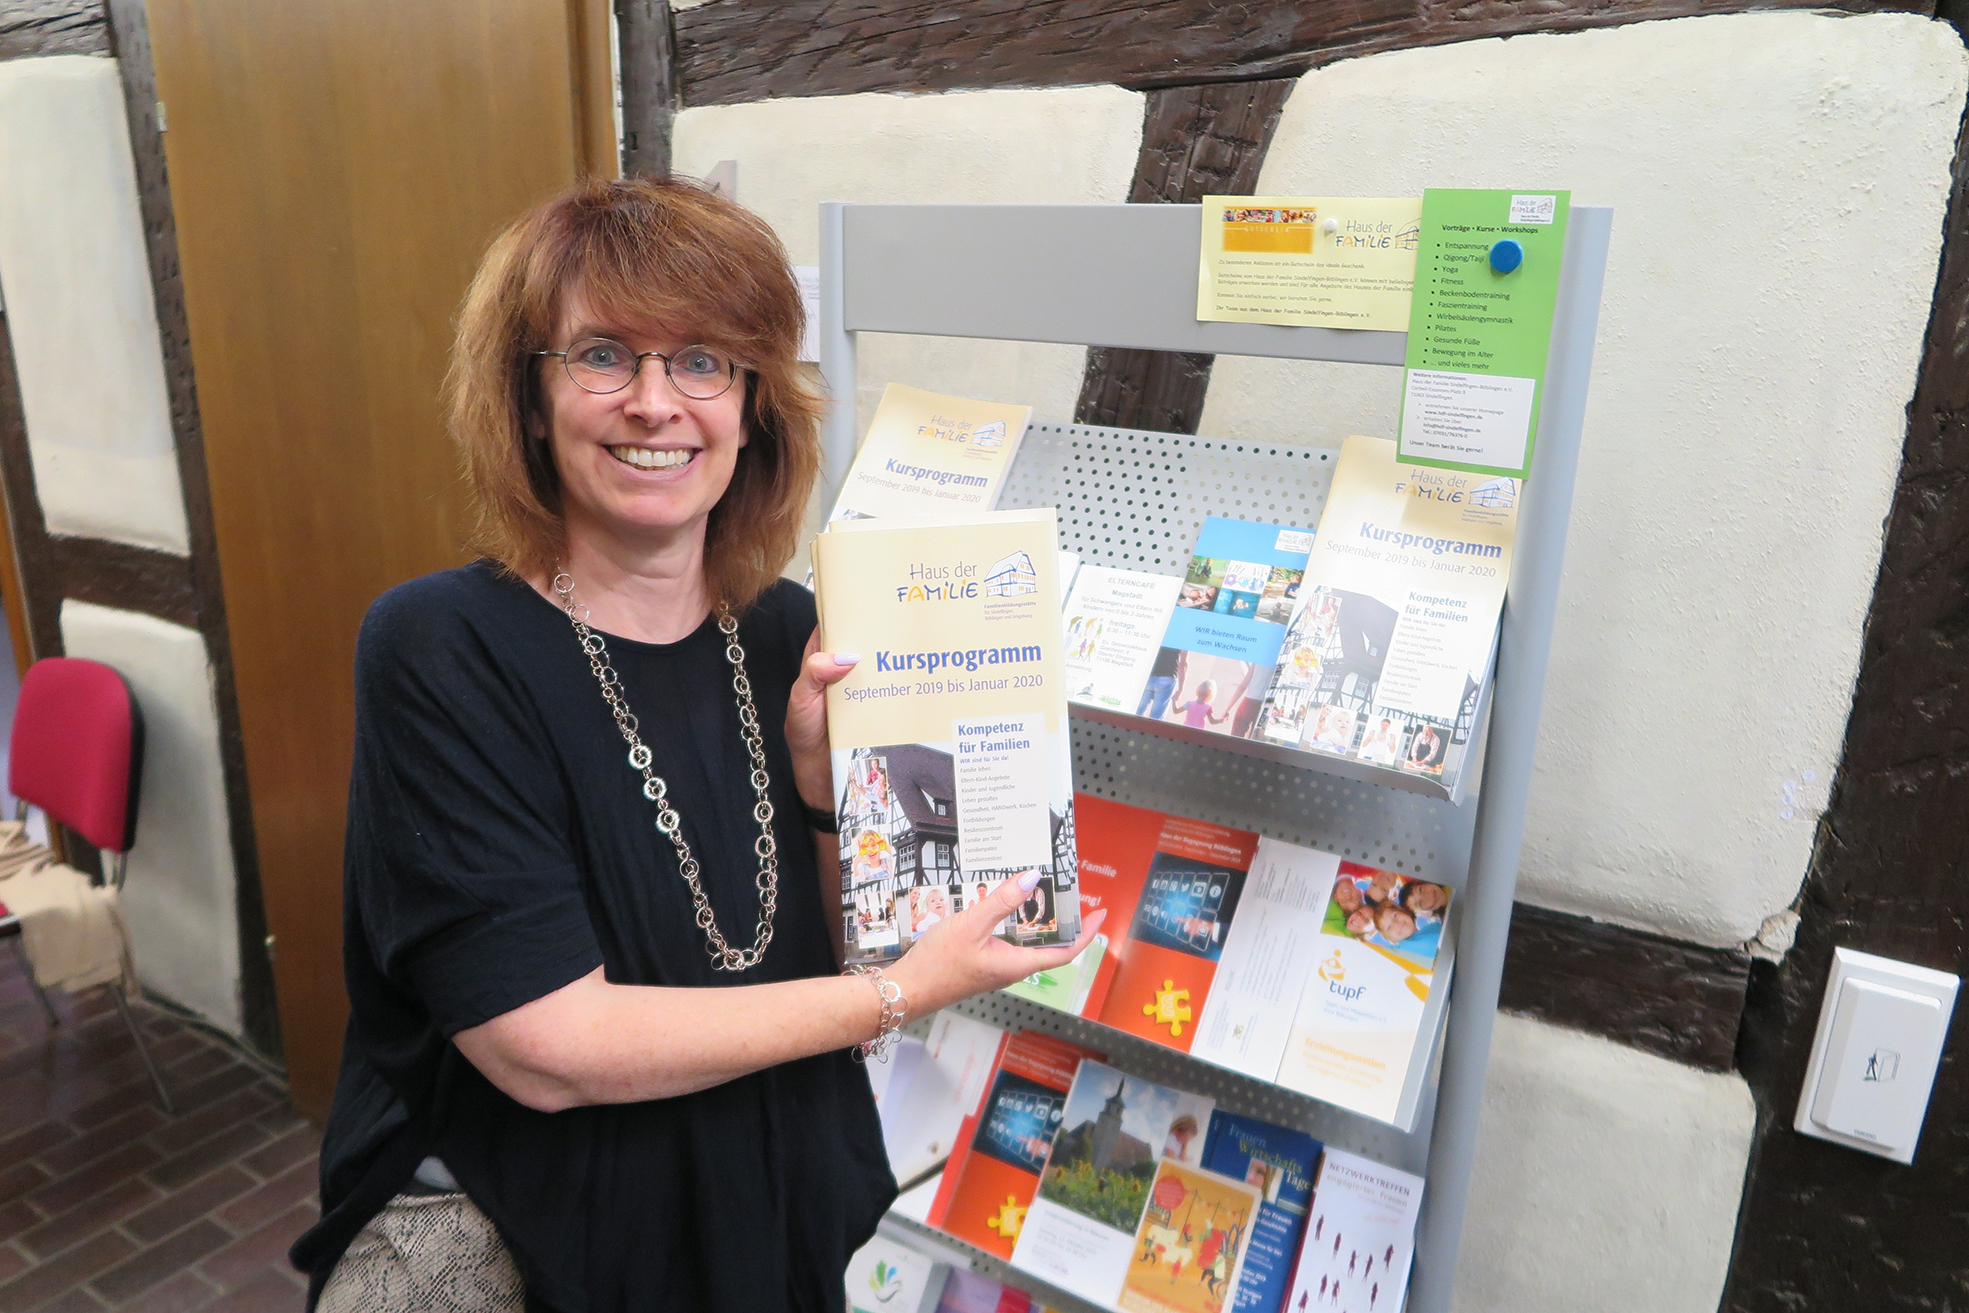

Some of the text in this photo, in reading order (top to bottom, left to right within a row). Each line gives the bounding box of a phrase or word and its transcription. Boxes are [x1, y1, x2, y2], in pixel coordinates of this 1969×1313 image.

[1346, 220, 1392, 233] Haus der
[1502, 226, 1538, 234] Workshops
[1445, 242, 1489, 251] Entspannung
[1442, 266, 1458, 274] Yoga
[1440, 290, 1510, 301] Beckenbodentraining
[1438, 302, 1487, 311] Faszientraining
[1437, 313, 1513, 324] Wirbelsäulengymnastik
[1432, 348, 1466, 357] Bewegung
[931, 415, 973, 430] Haus der
[885, 458, 988, 488] Kursprogramm
[1410, 469, 1468, 489] Haus der
[857, 471, 981, 503] September 2019 bis Januar 2020
[1360, 522, 1502, 558] Kursprogramm
[1326, 540, 1382, 561] September
[1384, 552, 1409, 565] 2019
[1412, 556, 1427, 568] bis
[1429, 559, 1466, 574] Januar
[1469, 564, 1496, 578] 2020
[910, 561, 978, 580] Haus der
[1108, 577, 1156, 589] ELTERNCAFÉ
[1112, 589, 1143, 599] Magstadt
[1409, 591, 1467, 609] Kompetenz
[1405, 605, 1468, 622] für Familien
[1109, 620, 1135, 629] freitags
[1195, 625, 1257, 643] WIR bieten Raum
[1214, 639, 1247, 653] Wachsen
[876, 644, 1042, 674] Kursprogramm
[844, 674, 1043, 703] September 2019 bis Januar 2020
[958, 722, 1024, 737] Kompetenz
[959, 739, 1030, 753] für Familien
[1081, 860, 1116, 877] Familie
[1329, 980, 1367, 1001] tupf
[1229, 1124, 1267, 1147] Frauen
[1286, 1169, 1311, 1191] Tage
[1329, 1162, 1410, 1197] NETZWERKTREFFEN
[1327, 1174, 1375, 1195] engagierter
[1380, 1191, 1408, 1207] Frauen
